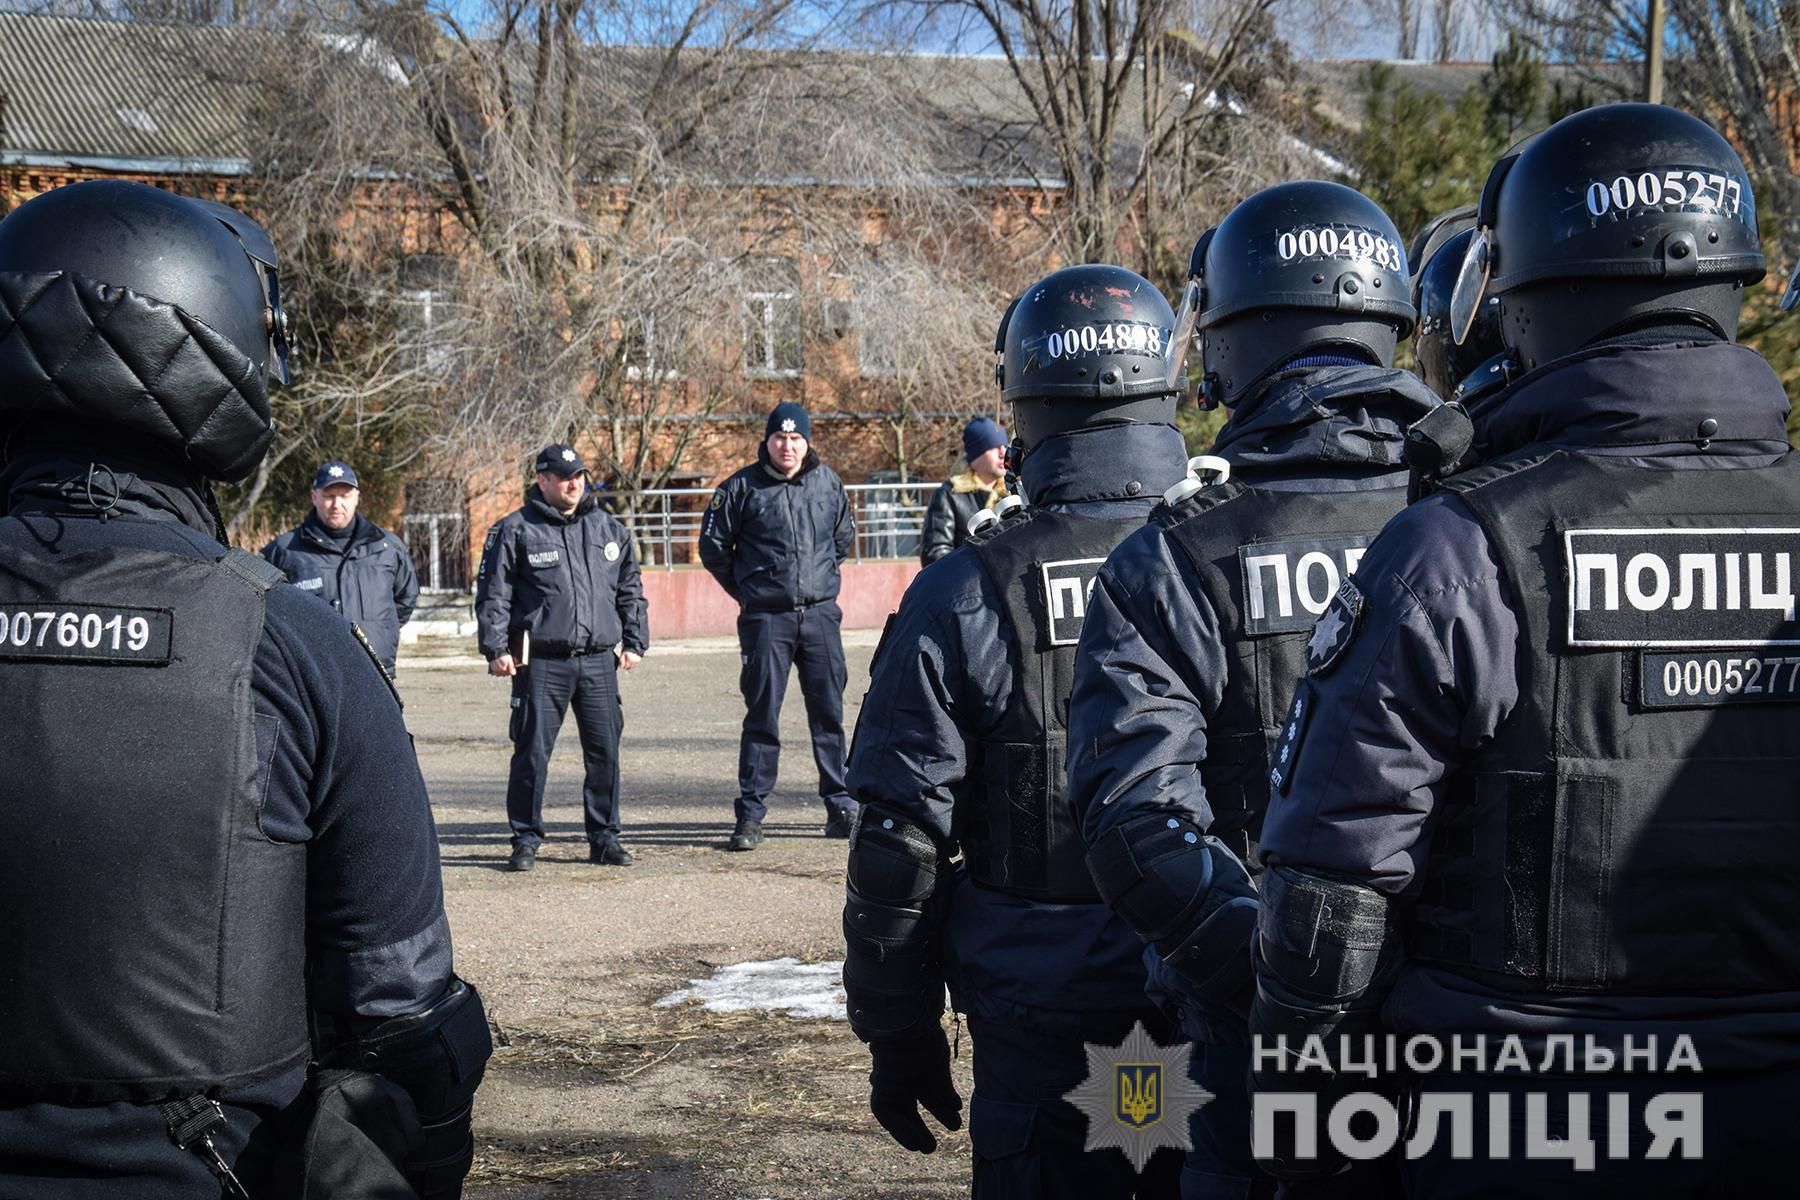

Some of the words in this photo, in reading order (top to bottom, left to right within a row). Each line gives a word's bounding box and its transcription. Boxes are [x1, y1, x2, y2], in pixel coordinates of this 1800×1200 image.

[1586, 171, 1741, 216] 0005277
[1278, 228, 1400, 272] 0004983
[1575, 552, 1795, 622] ПОЛІЦ
